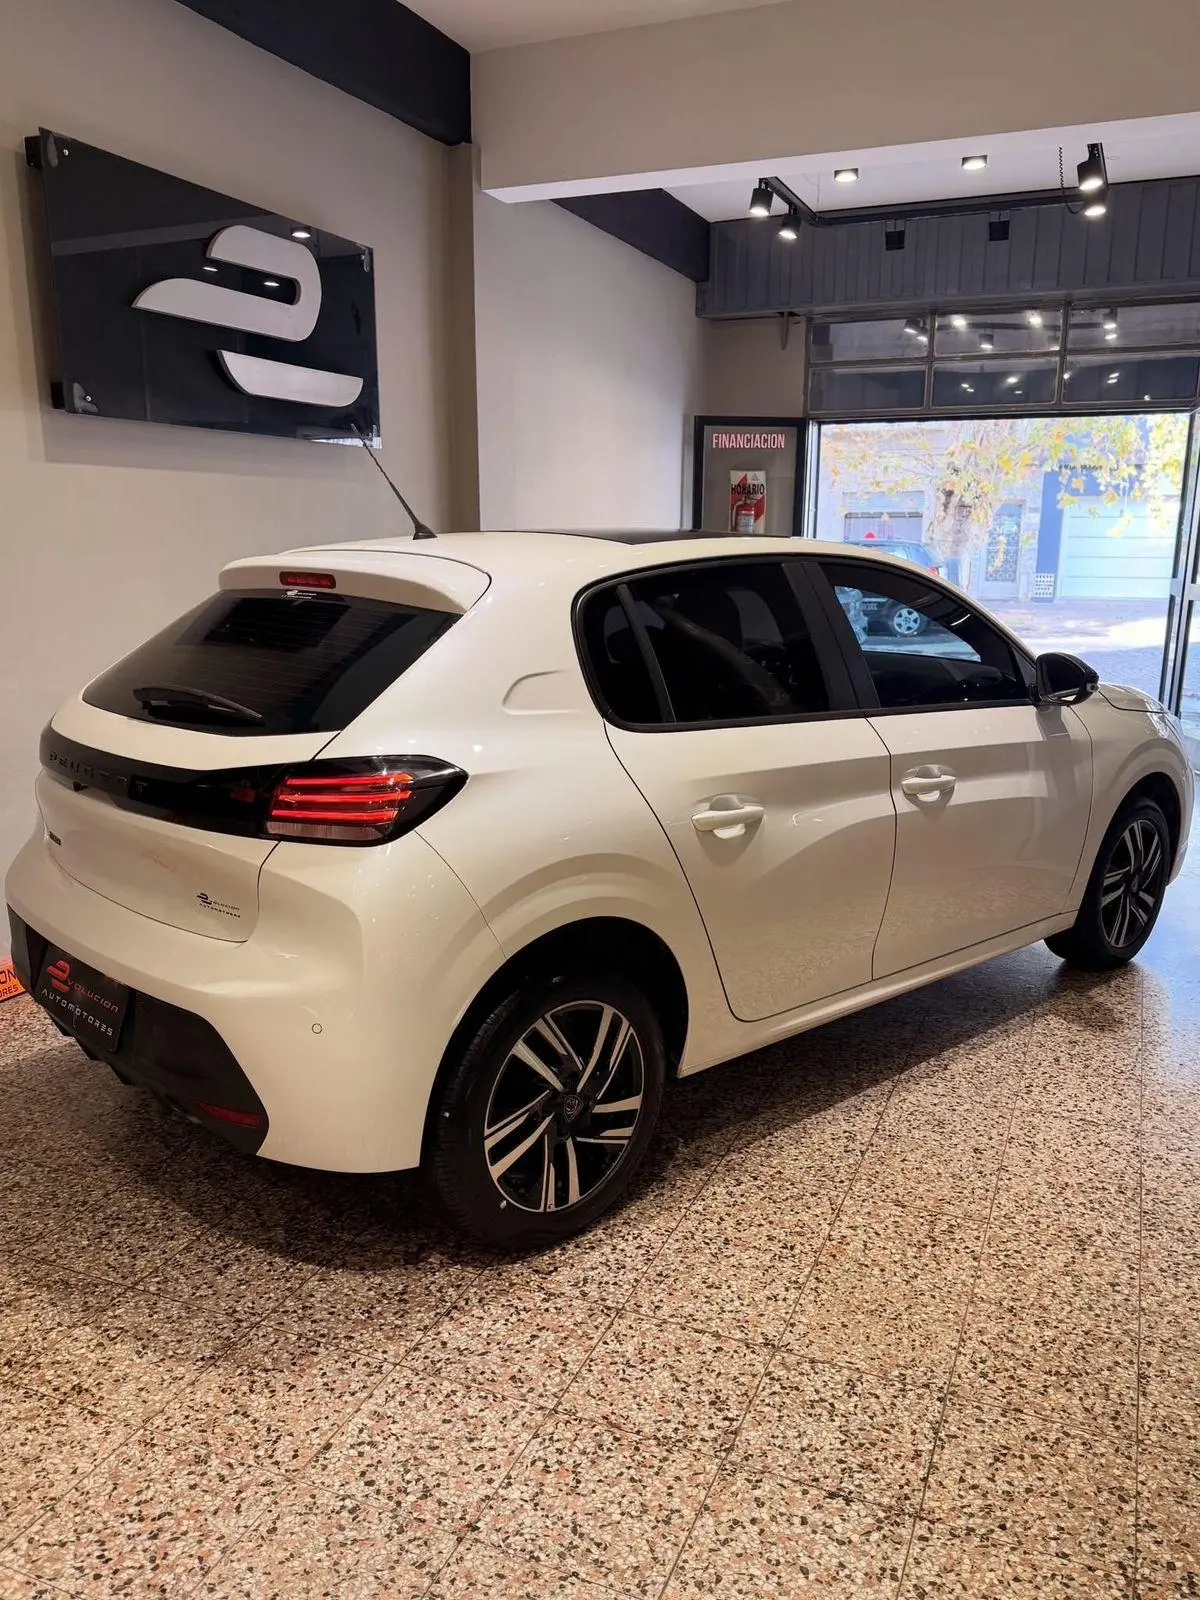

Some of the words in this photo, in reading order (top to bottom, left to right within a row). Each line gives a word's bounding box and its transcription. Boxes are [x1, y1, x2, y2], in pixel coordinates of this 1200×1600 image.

[712, 433, 786, 449] FINANCIACION
[730, 483, 766, 496] HORARIO
[41, 988, 114, 1036] AUTOMOTORES
